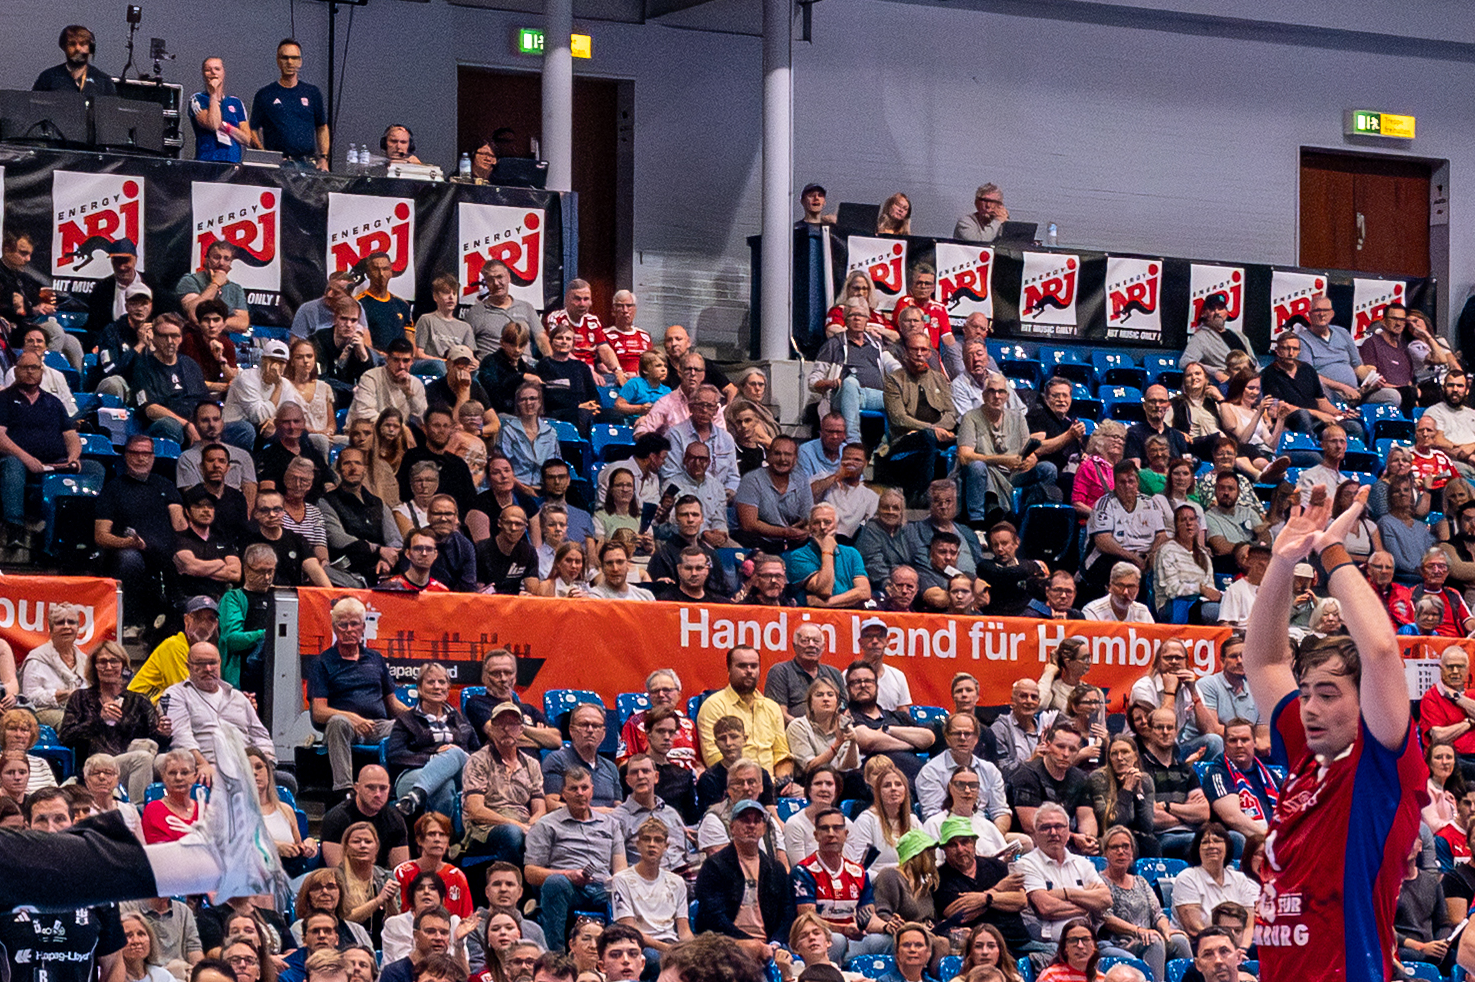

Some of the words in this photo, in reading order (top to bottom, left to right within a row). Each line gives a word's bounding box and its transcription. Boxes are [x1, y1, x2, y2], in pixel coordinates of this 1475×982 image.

[58, 194, 120, 220] ENERGY
[197, 205, 258, 230] ENERGY
[56, 180, 139, 268] NRJ
[332, 216, 392, 242] ENERGY
[464, 226, 522, 252] ENERGY
[52, 279, 71, 292] HIT
[72, 281, 96, 294] MUS
[938, 250, 990, 306] NRJ
[1022, 258, 1077, 316] NRJ
[247, 292, 274, 306] ONLY
[1109, 264, 1159, 321] NRJ
[680, 607, 788, 652] Hand
[969, 622, 1025, 661] für
[1037, 624, 1216, 678] Hmbg
[35, 950, 91, 963] Hapag-Lloyd
